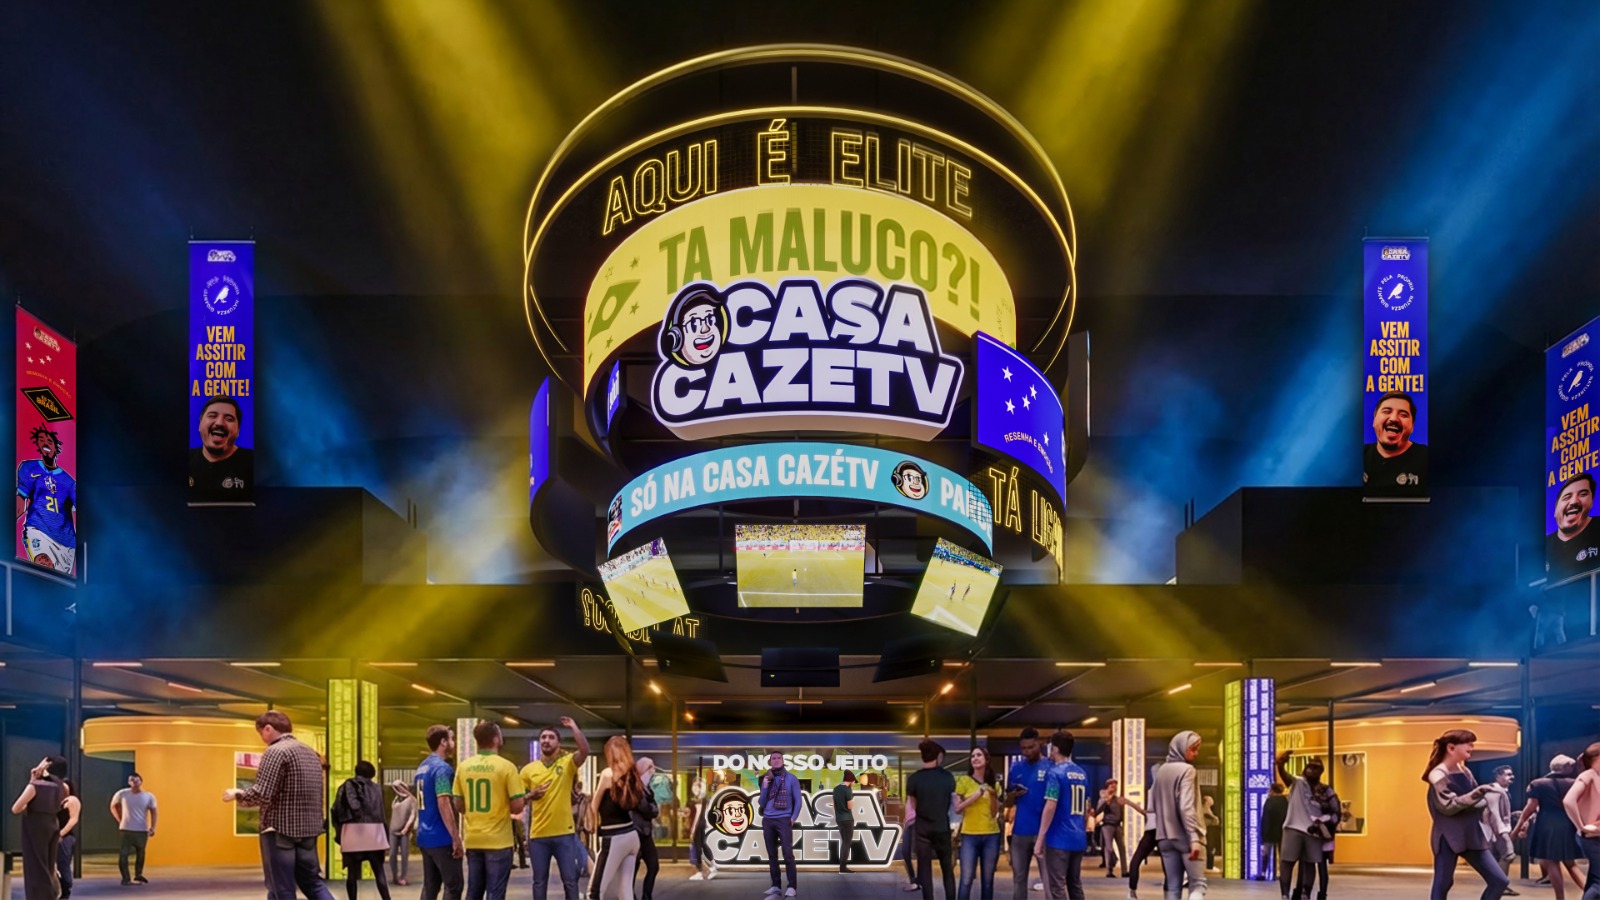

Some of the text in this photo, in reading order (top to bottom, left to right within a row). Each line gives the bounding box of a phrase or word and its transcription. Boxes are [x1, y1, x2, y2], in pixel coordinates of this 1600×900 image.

[602, 118, 973, 236] AQUI É ELITE
[658, 225, 713, 295] TA
[729, 207, 980, 322] MALUCO?!
[726, 284, 934, 354] CASA
[1380, 321, 1409, 339] VEM
[206, 326, 235, 343] VEM
[1369, 339, 1421, 357] ASSITIR
[195, 343, 246, 361] ASSITIR
[1380, 357, 1410, 375] COM
[205, 361, 236, 379] COM
[658, 347, 956, 416] CAZETV
[1365, 374, 1424, 392] A GENTE!
[191, 379, 250, 397] A GENTE!
[1561, 403, 1589, 431] VEM
[1003, 431, 1033, 444] RESENHA
[1551, 416, 1600, 454] ASSITIR
[1560, 437, 1590, 465] COM
[1547, 449, 1600, 488] A GENTE
[630, 472, 657, 518] SÓ
[663, 467, 696, 504] NA
[703, 455, 770, 493] CASA
[778, 448, 879, 490] CAZÉTV
[45, 495, 59, 513] 21
[988, 466, 1022, 532] TÁ
[713, 754, 745, 771] DO
[827, 754, 888, 771] JEITO
[466, 777, 491, 813] 10
[1070, 784, 1086, 816] 10
